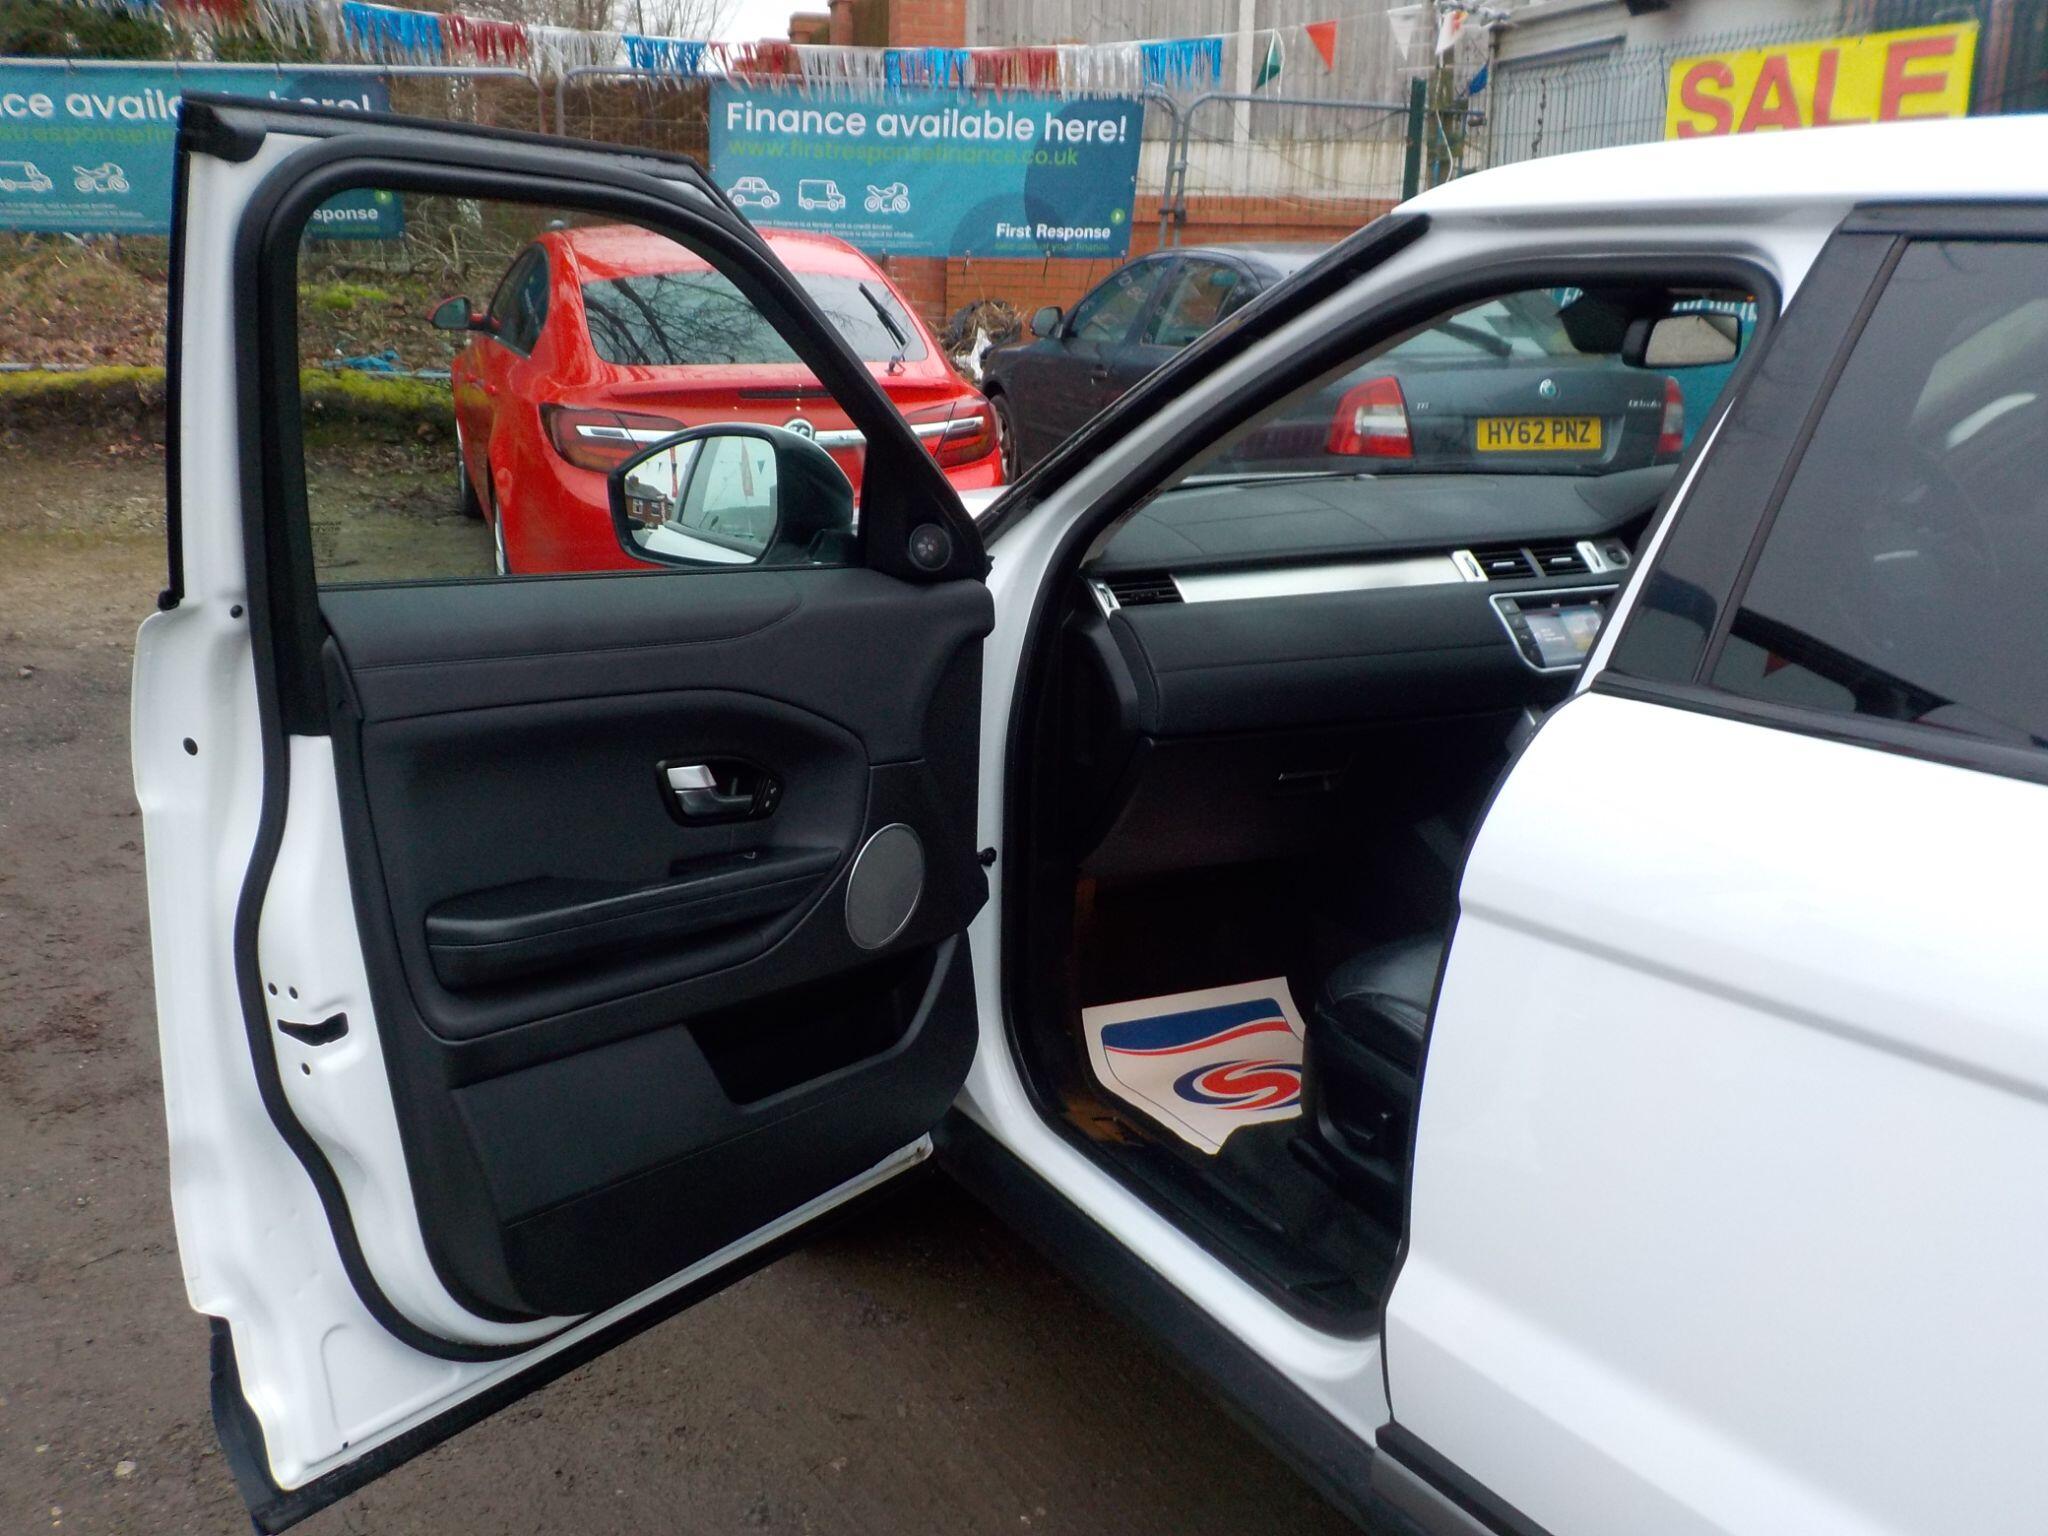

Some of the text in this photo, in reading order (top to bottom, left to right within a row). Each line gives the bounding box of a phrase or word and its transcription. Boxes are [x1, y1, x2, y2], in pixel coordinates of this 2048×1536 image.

[1677, 37, 1957, 139] SALE
[727, 101, 1127, 143] Finance available here!
[729, 139, 1078, 167] www.firstresponsefinance.co.uk
[996, 222, 1111, 242] First Response
[1487, 420, 1591, 445] HY62 PNZ
